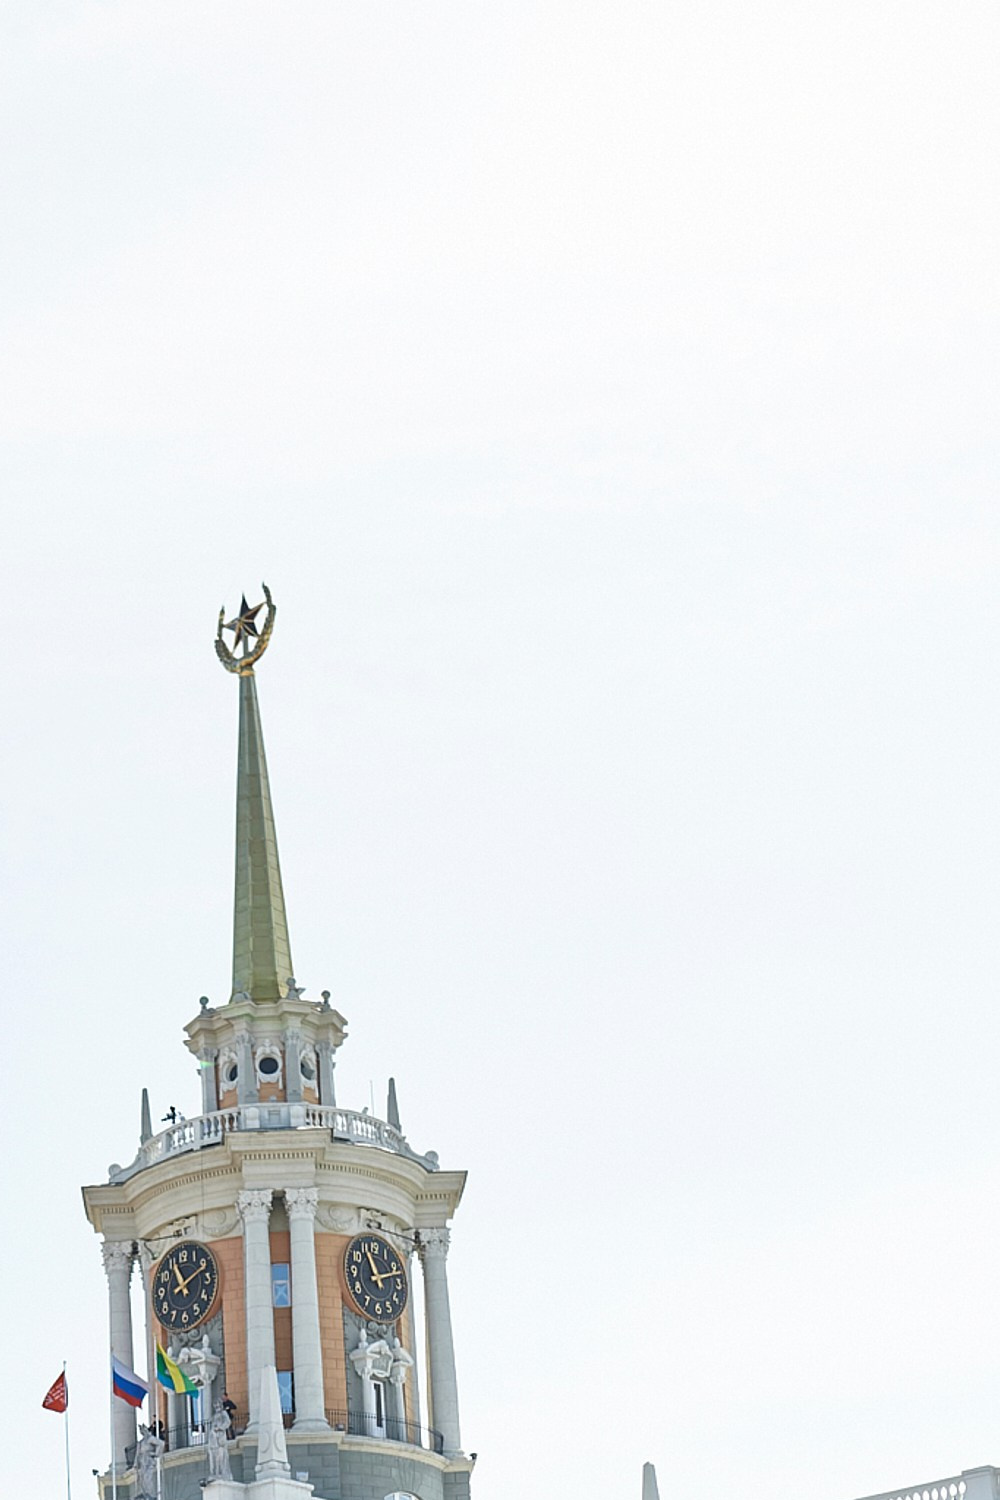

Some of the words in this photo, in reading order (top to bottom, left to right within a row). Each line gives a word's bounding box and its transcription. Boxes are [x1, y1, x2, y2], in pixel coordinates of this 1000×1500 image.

[361, 1242, 368, 1253] 11
[371, 1242, 379, 1254] 12
[179, 1250, 187, 1263] 12
[353, 1250, 362, 1263] 10
[169, 1257, 175, 1270] 11
[161, 1271, 169, 1283] 10
[351, 1265, 357, 1277] 9
[204, 1272, 211, 1284] 3
[396, 1278, 402, 1290] 3
[158, 1287, 165, 1300] 9
[355, 1281, 361, 1294] 8
[201, 1289, 207, 1301] 4
[364, 1295, 370, 1306] 7
[393, 1292, 399, 1304] 4
[162, 1301, 168, 1314] 8
[193, 1303, 200, 1315] 5
[375, 1302, 382, 1314] 6
[385, 1301, 392, 1313] 5
[171, 1310, 177, 1322] 7
[182, 1311, 189, 1323] 6
